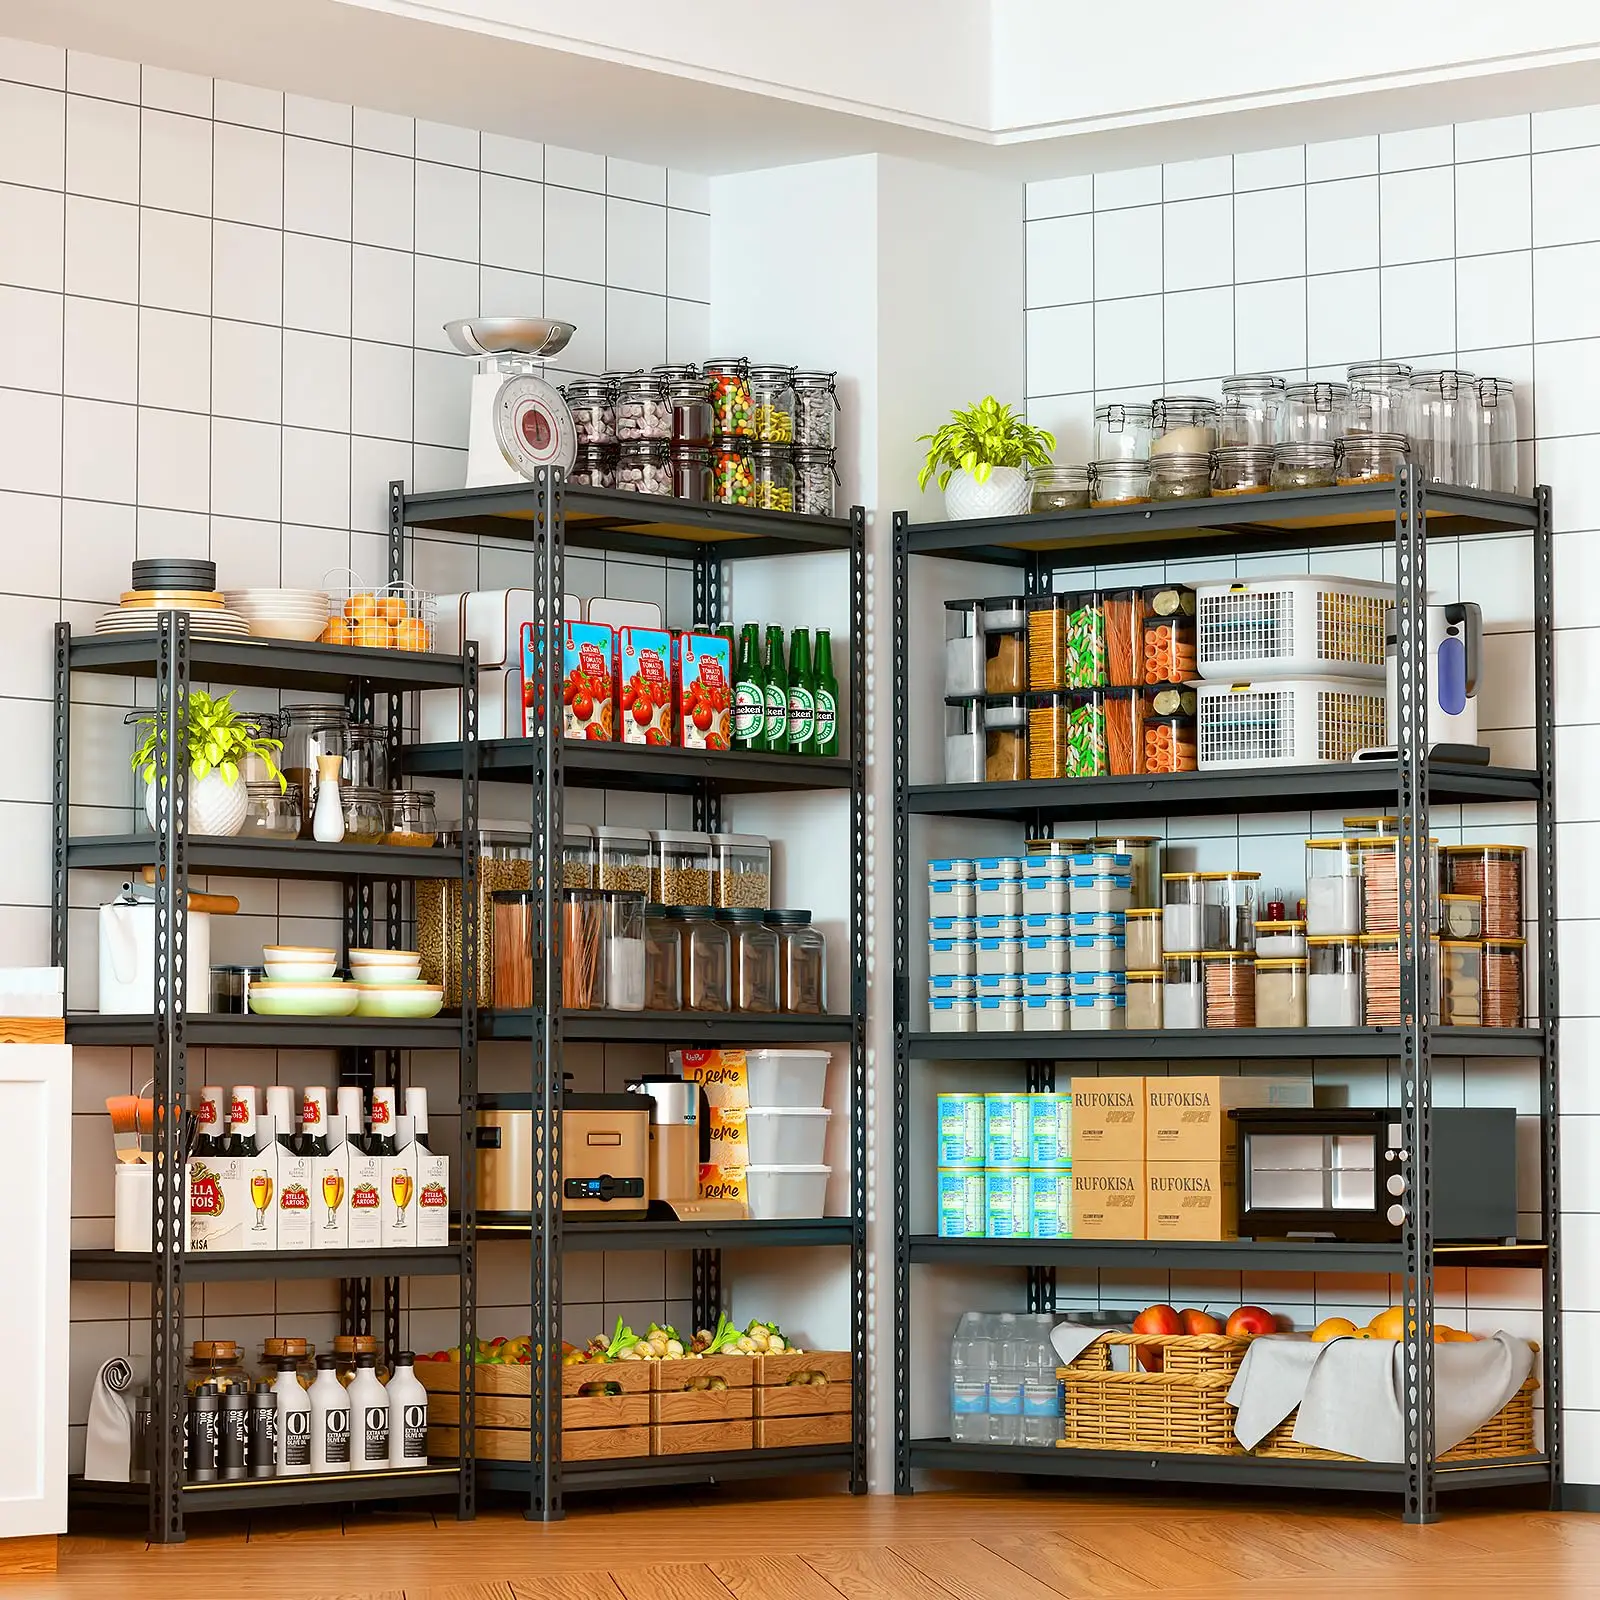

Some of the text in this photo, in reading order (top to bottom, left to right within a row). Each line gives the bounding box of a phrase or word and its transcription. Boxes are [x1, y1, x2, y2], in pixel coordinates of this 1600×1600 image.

[582, 656, 602, 664] TOMATO
[642, 662, 661, 670] TOMATO
[702, 667, 720, 676] TOMATO
[1074, 1092, 1134, 1106] RUFOKISA
[1150, 1092, 1211, 1106] RUFOKISA
[1075, 1176, 1135, 1190] RUFOKISA
[1151, 1178, 1211, 1192] RUFOKISA
[206, 1412, 214, 1444] WALNUT
